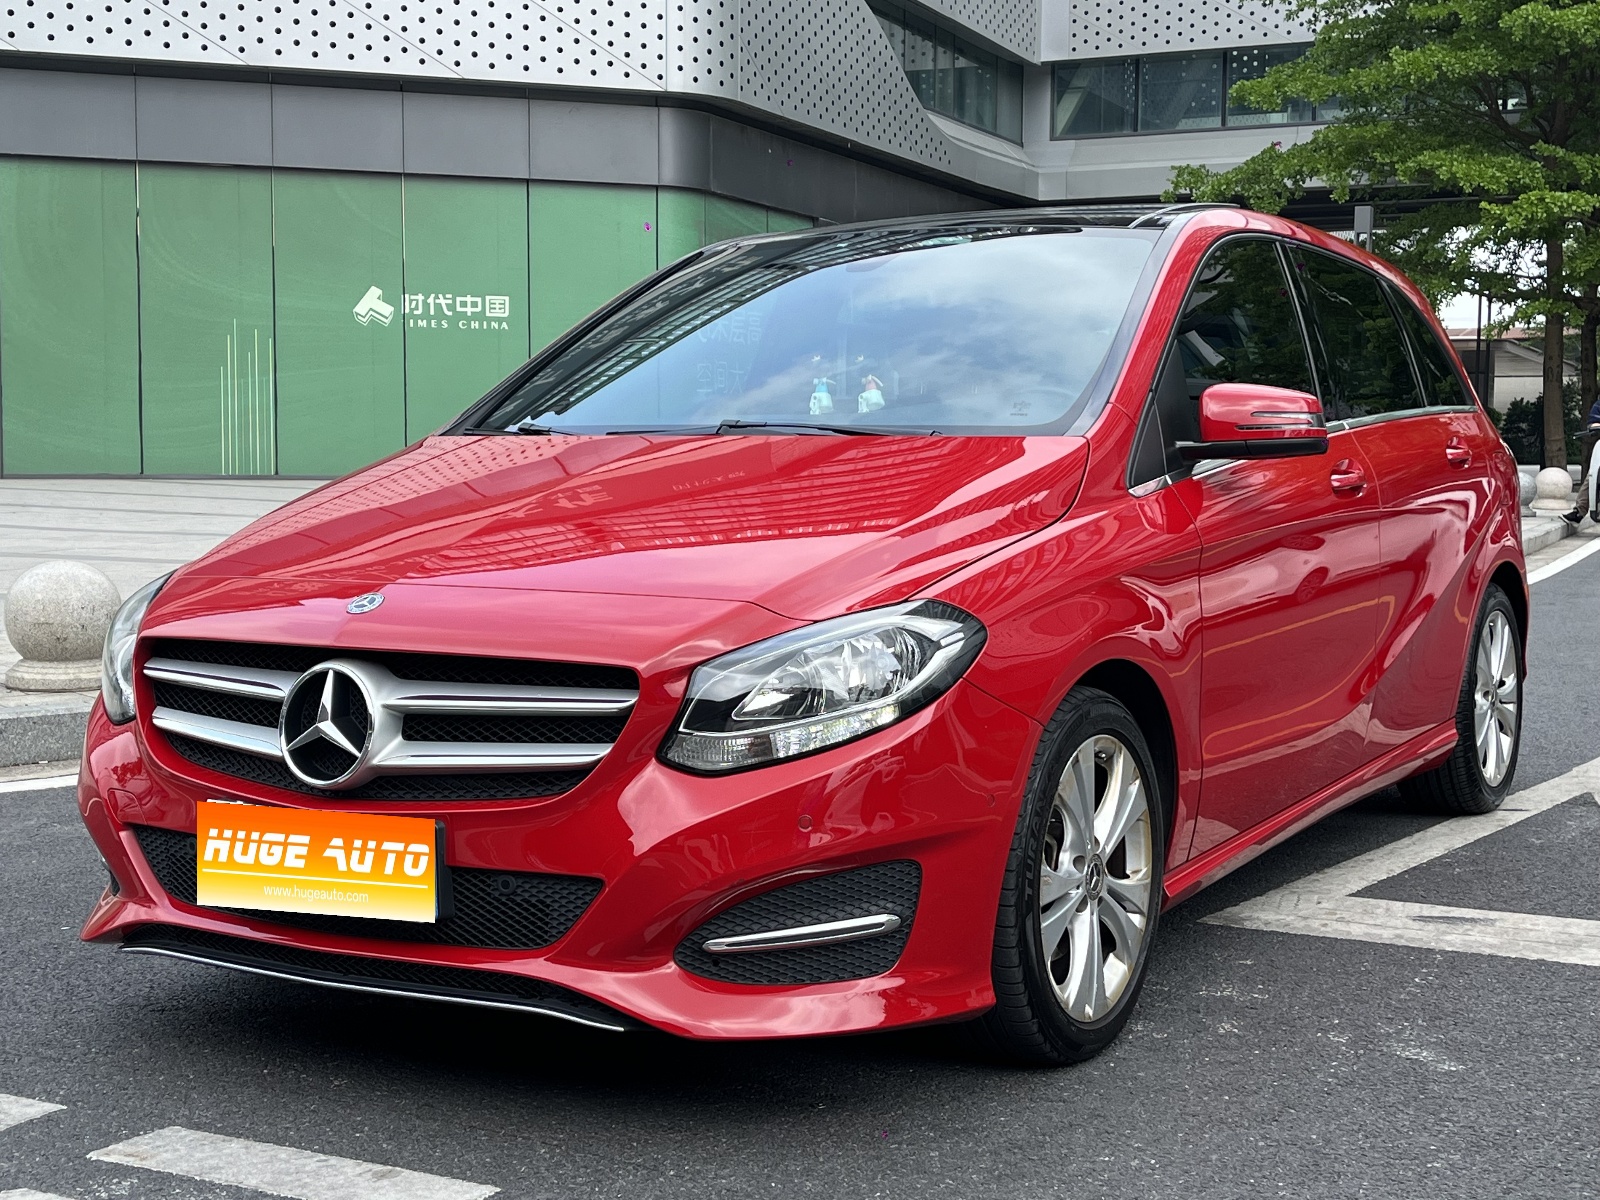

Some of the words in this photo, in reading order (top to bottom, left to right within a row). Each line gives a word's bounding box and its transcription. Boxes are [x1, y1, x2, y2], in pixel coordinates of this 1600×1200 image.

[401, 293, 509, 317] 时代中国
[402, 319, 448, 328] IMES
[459, 320, 509, 330] CHINA
